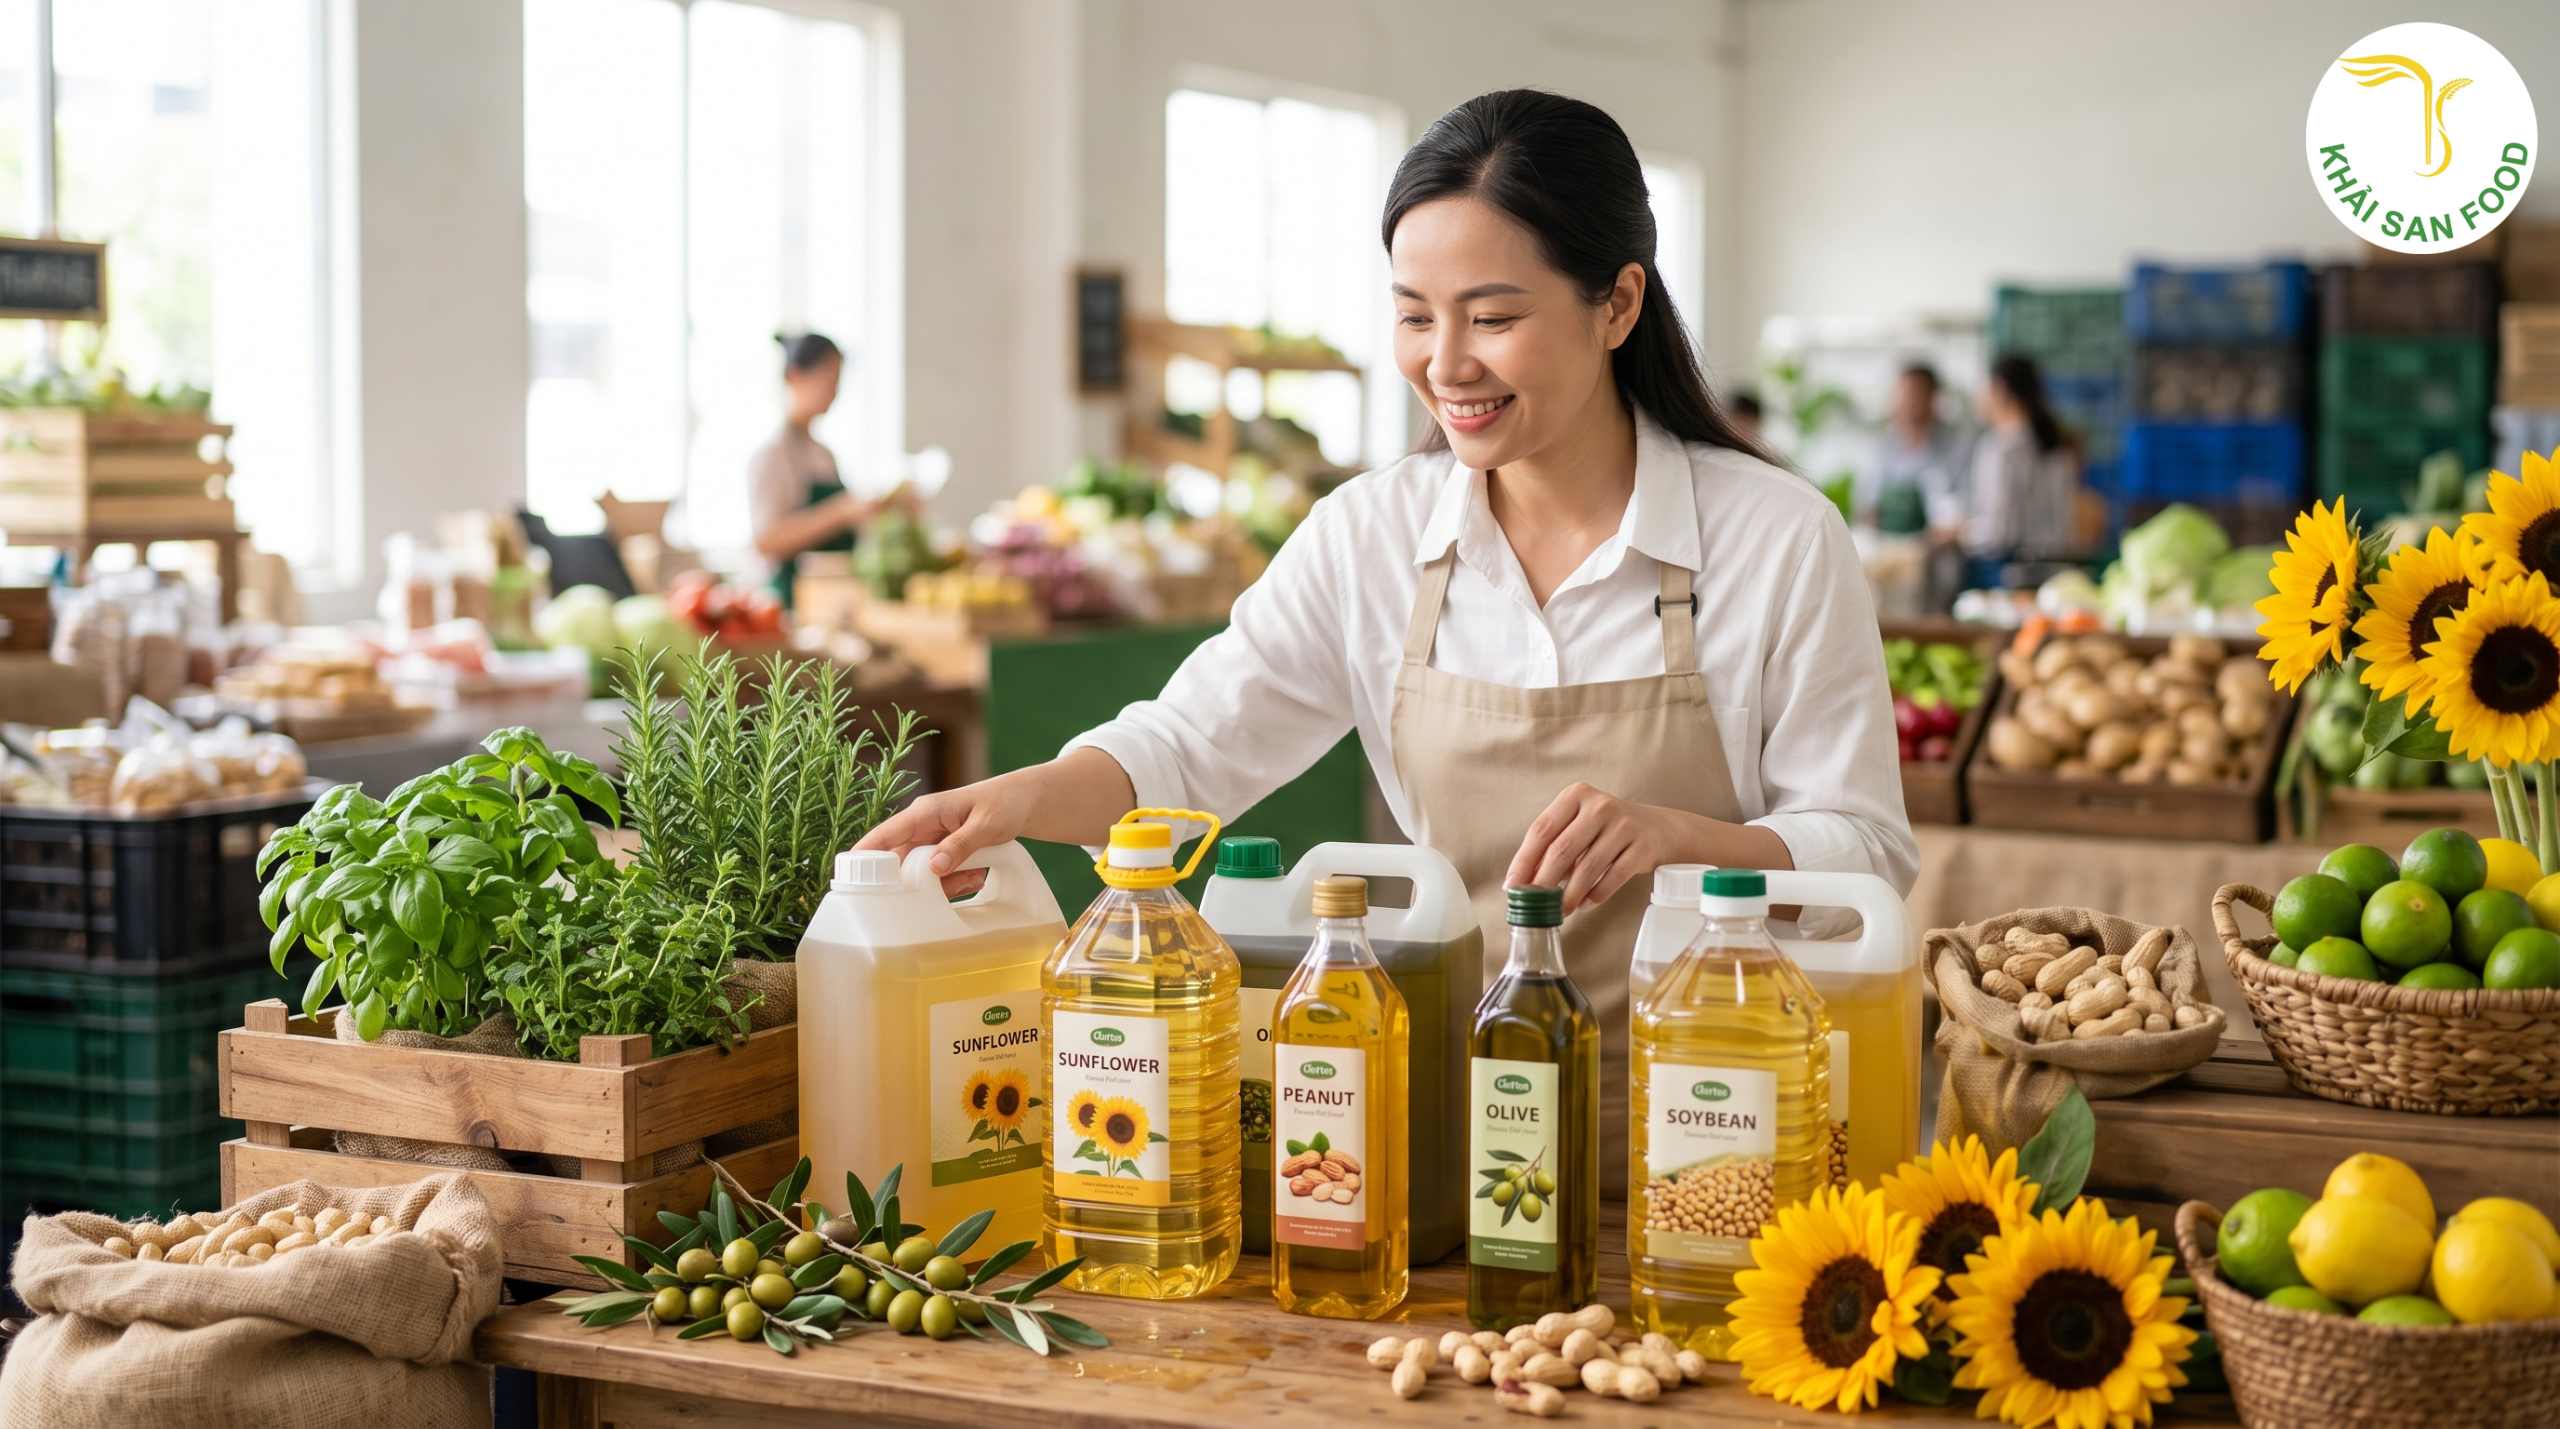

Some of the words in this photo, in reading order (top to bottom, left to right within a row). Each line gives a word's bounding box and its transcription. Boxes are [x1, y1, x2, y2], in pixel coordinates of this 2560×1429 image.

[953, 1028, 1038, 1055] SUNFLOWER
[1059, 1052, 1160, 1074] SUNFLOWER
[1284, 1087, 1355, 1107] PEANUT
[1486, 1104, 1540, 1122] OLIVE
[1667, 1109, 1756, 1130] SOYBEAN
